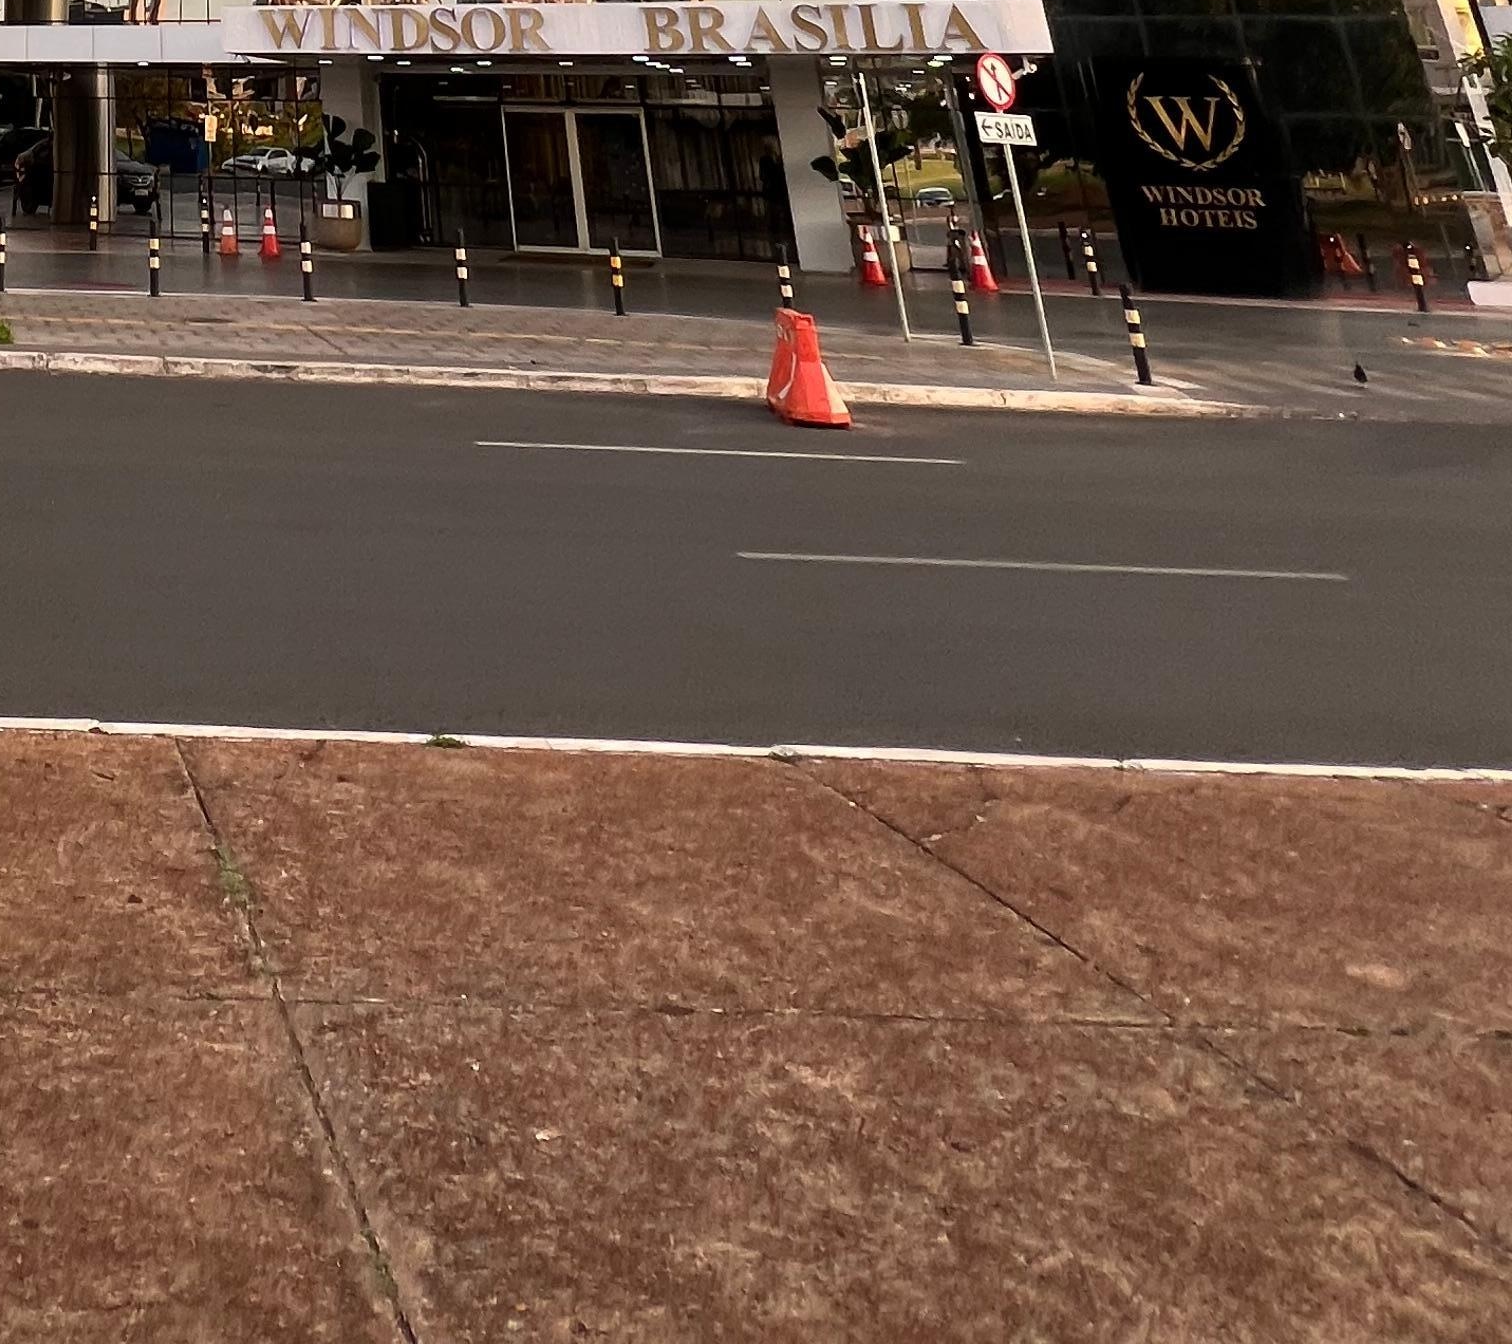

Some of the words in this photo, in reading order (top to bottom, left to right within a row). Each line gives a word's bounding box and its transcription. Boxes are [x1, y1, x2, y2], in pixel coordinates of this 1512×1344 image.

[258, 6, 554, 52] WINDSOR
[639, 3, 990, 53] BRASILIA
[1143, 95, 1222, 152] W
[1140, 185, 1268, 207] WINDSOR
